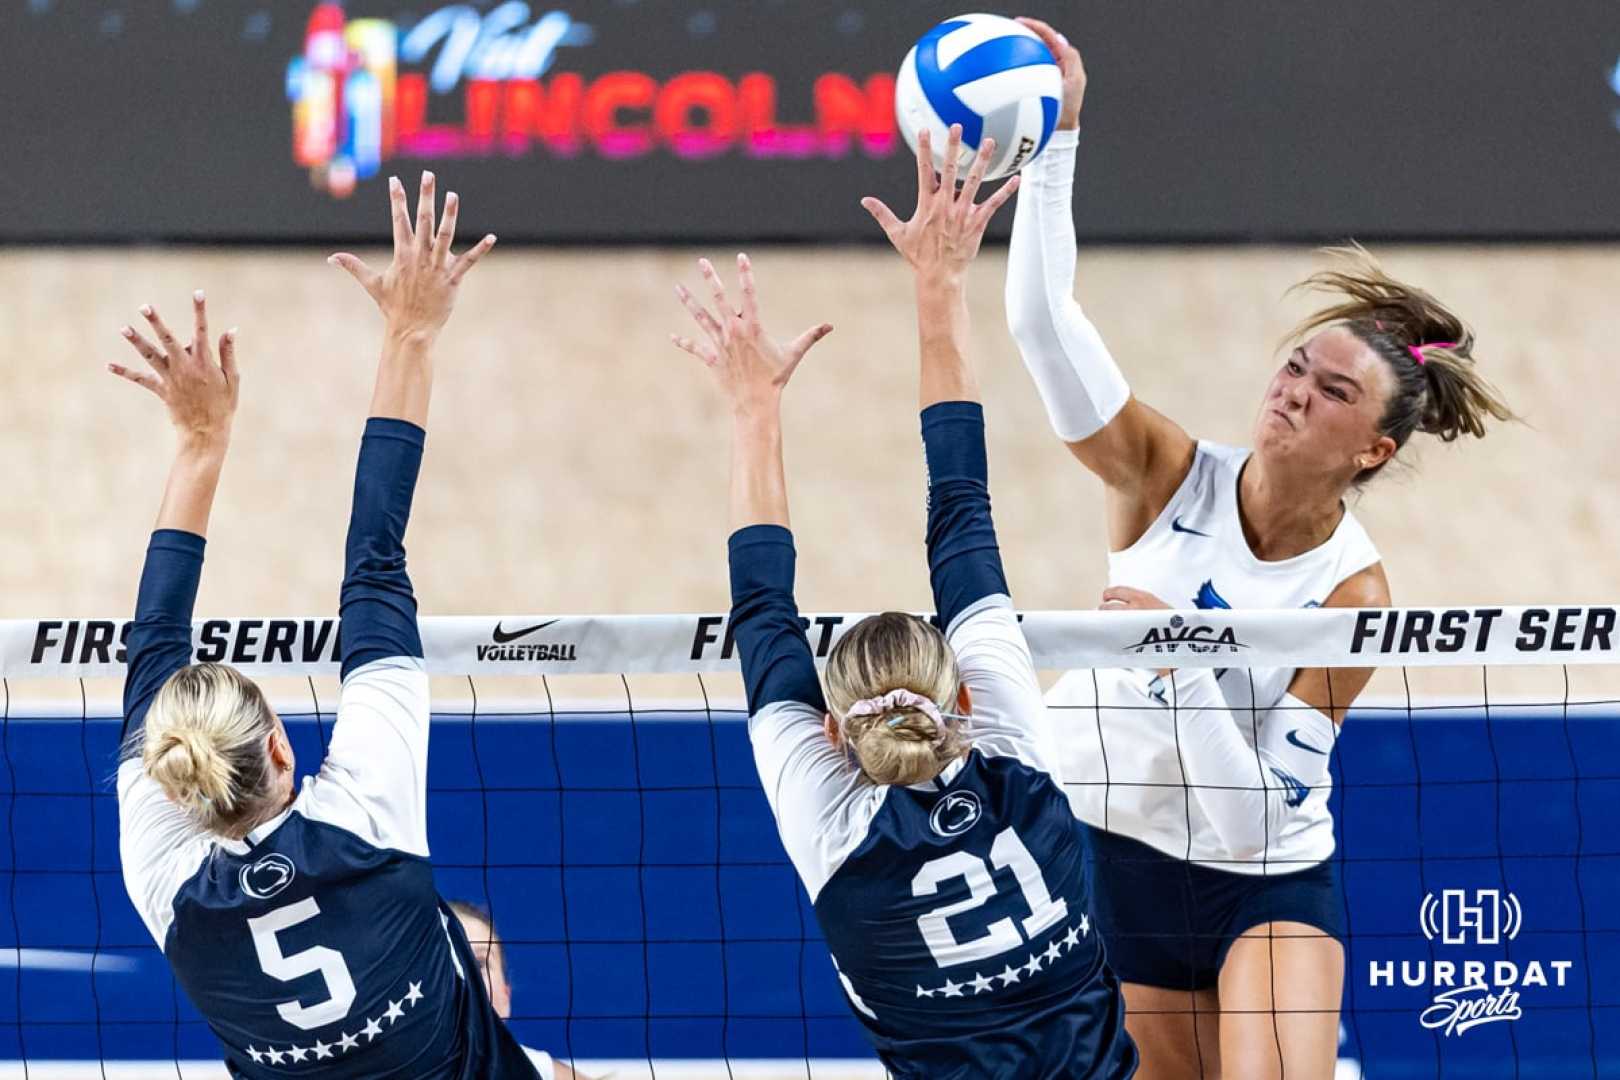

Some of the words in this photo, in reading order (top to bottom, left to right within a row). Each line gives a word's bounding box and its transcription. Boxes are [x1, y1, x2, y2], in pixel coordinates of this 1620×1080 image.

[396, 71, 897, 158] LINCOLN
[31, 621, 134, 664] FIR
[197, 620, 342, 663] SERV
[691, 616, 844, 660] FIT
[1135, 626, 1239, 653] AVCA
[1350, 609, 1503, 653] FIRST
[1515, 608, 1616, 651] SER
[476, 645, 577, 661] VOLLEYBALL
[912, 826, 1068, 968] 21
[246, 896, 357, 1030] 5
